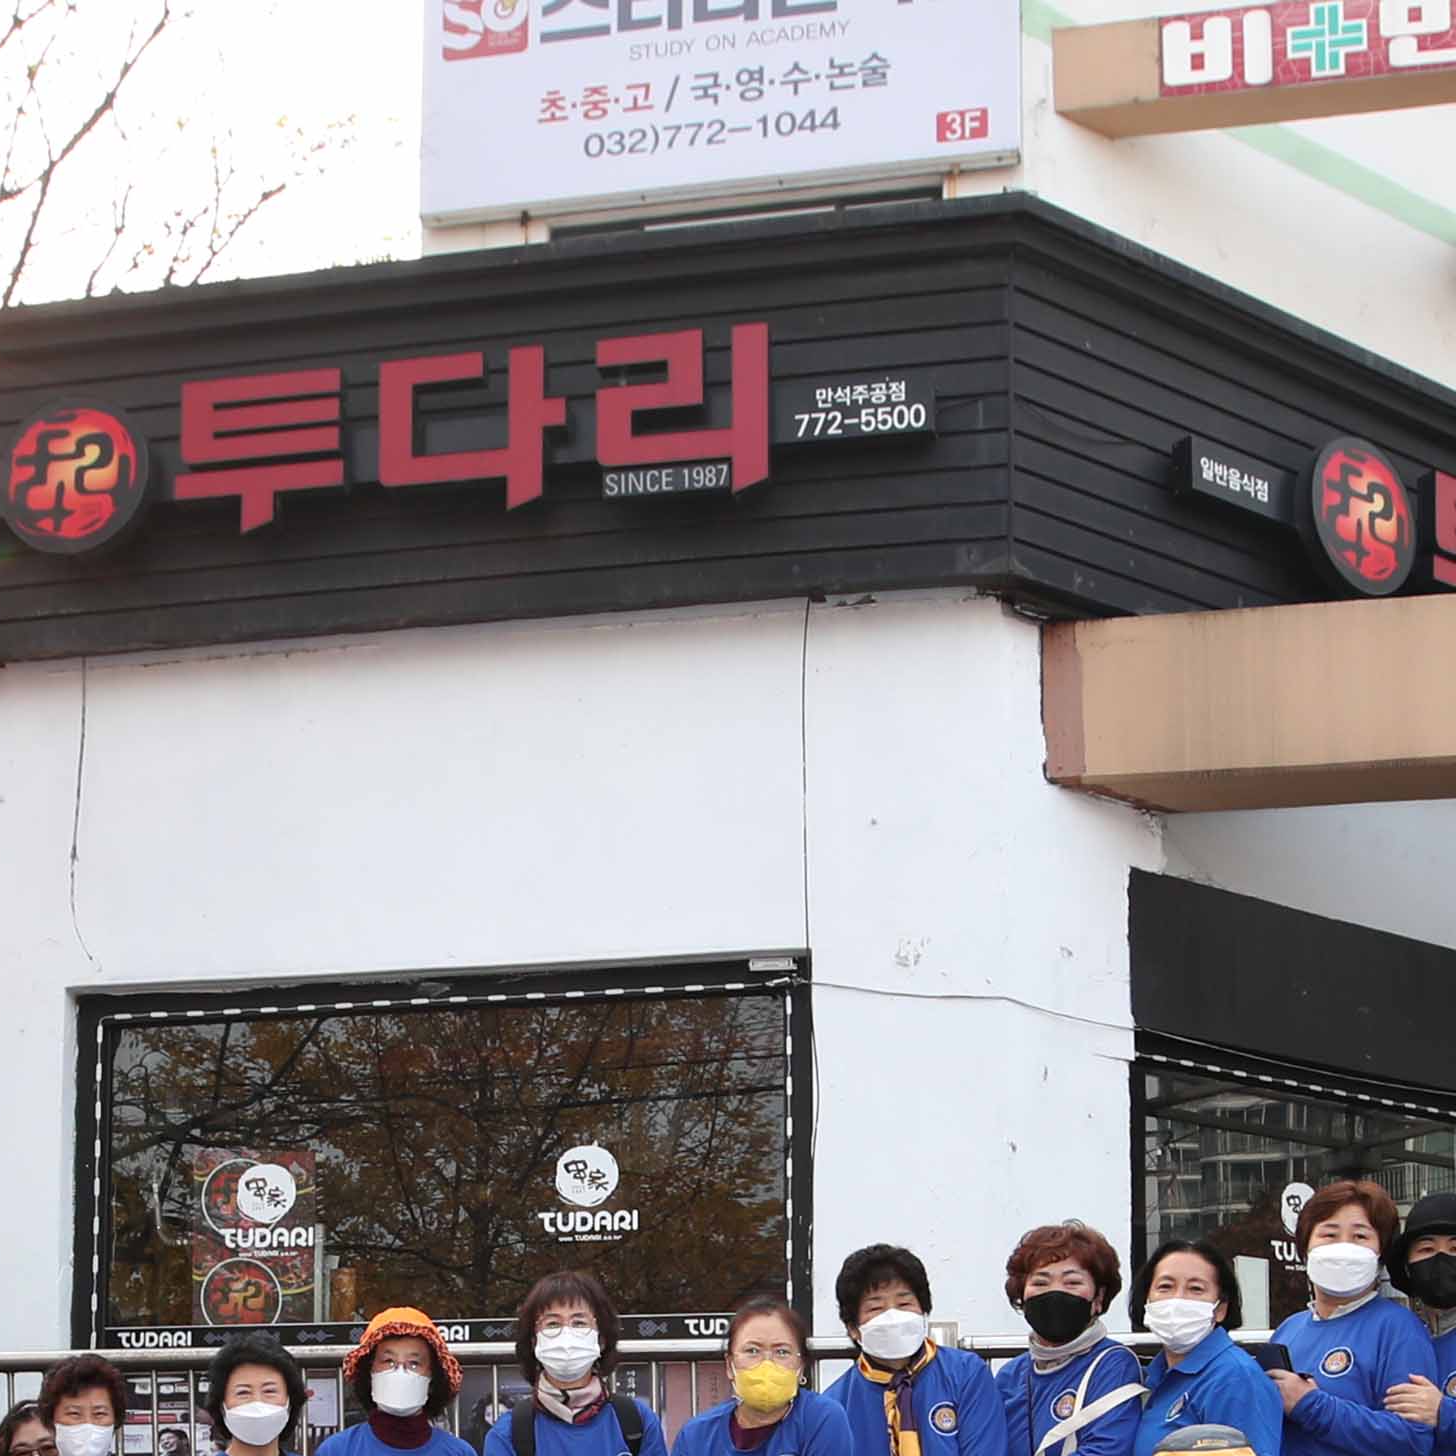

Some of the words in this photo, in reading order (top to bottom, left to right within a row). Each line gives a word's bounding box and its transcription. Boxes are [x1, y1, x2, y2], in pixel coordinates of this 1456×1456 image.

[629, 37, 696, 61] STUDY
[705, 34, 736, 52] ON
[746, 18, 852, 49] ACADEMY
[583, 105, 842, 158] 032)772-1044
[945, 110, 983, 140] 3F
[815, 380, 906, 408] 만석주공점
[175, 322, 768, 534] 투다리
[794, 403, 926, 438] 772-5500
[604, 467, 675, 497] SINCE
[681, 463, 729, 490] 1987
[1199, 455, 1270, 504] 일반음식점
[537, 1209, 639, 1233] TUDARI
[219, 1226, 315, 1249] TUDARI
[117, 1331, 193, 1348] TUDARI
[437, 1324, 470, 1342] ARI
[683, 1317, 728, 1336] TUD
